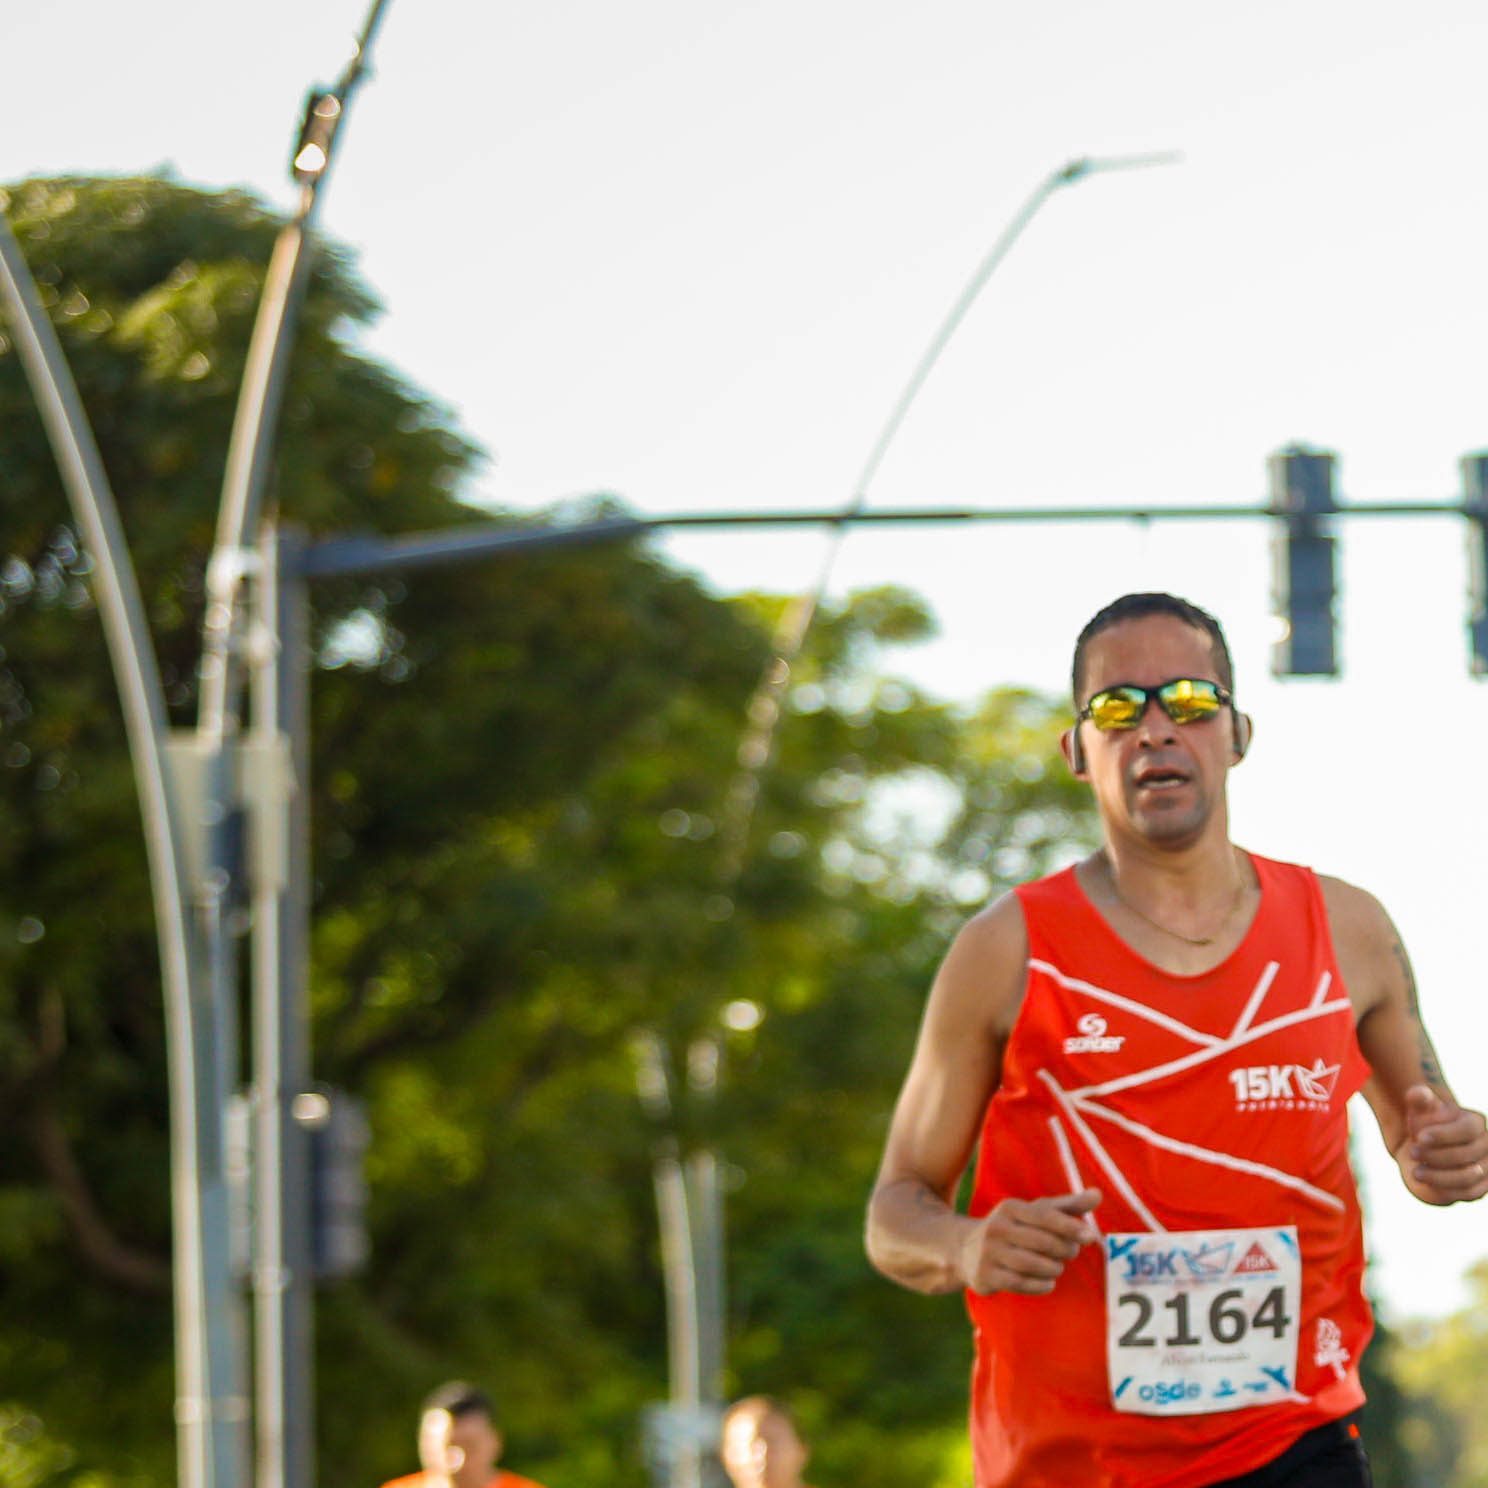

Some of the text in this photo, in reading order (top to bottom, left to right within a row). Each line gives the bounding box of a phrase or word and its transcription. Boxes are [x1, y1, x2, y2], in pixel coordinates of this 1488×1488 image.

[1228, 1065, 1296, 1101] 15K
[1127, 1251, 1177, 1277] 15K
[1118, 1286, 1291, 1347] 2164
[1139, 1380, 1202, 1402] osde
